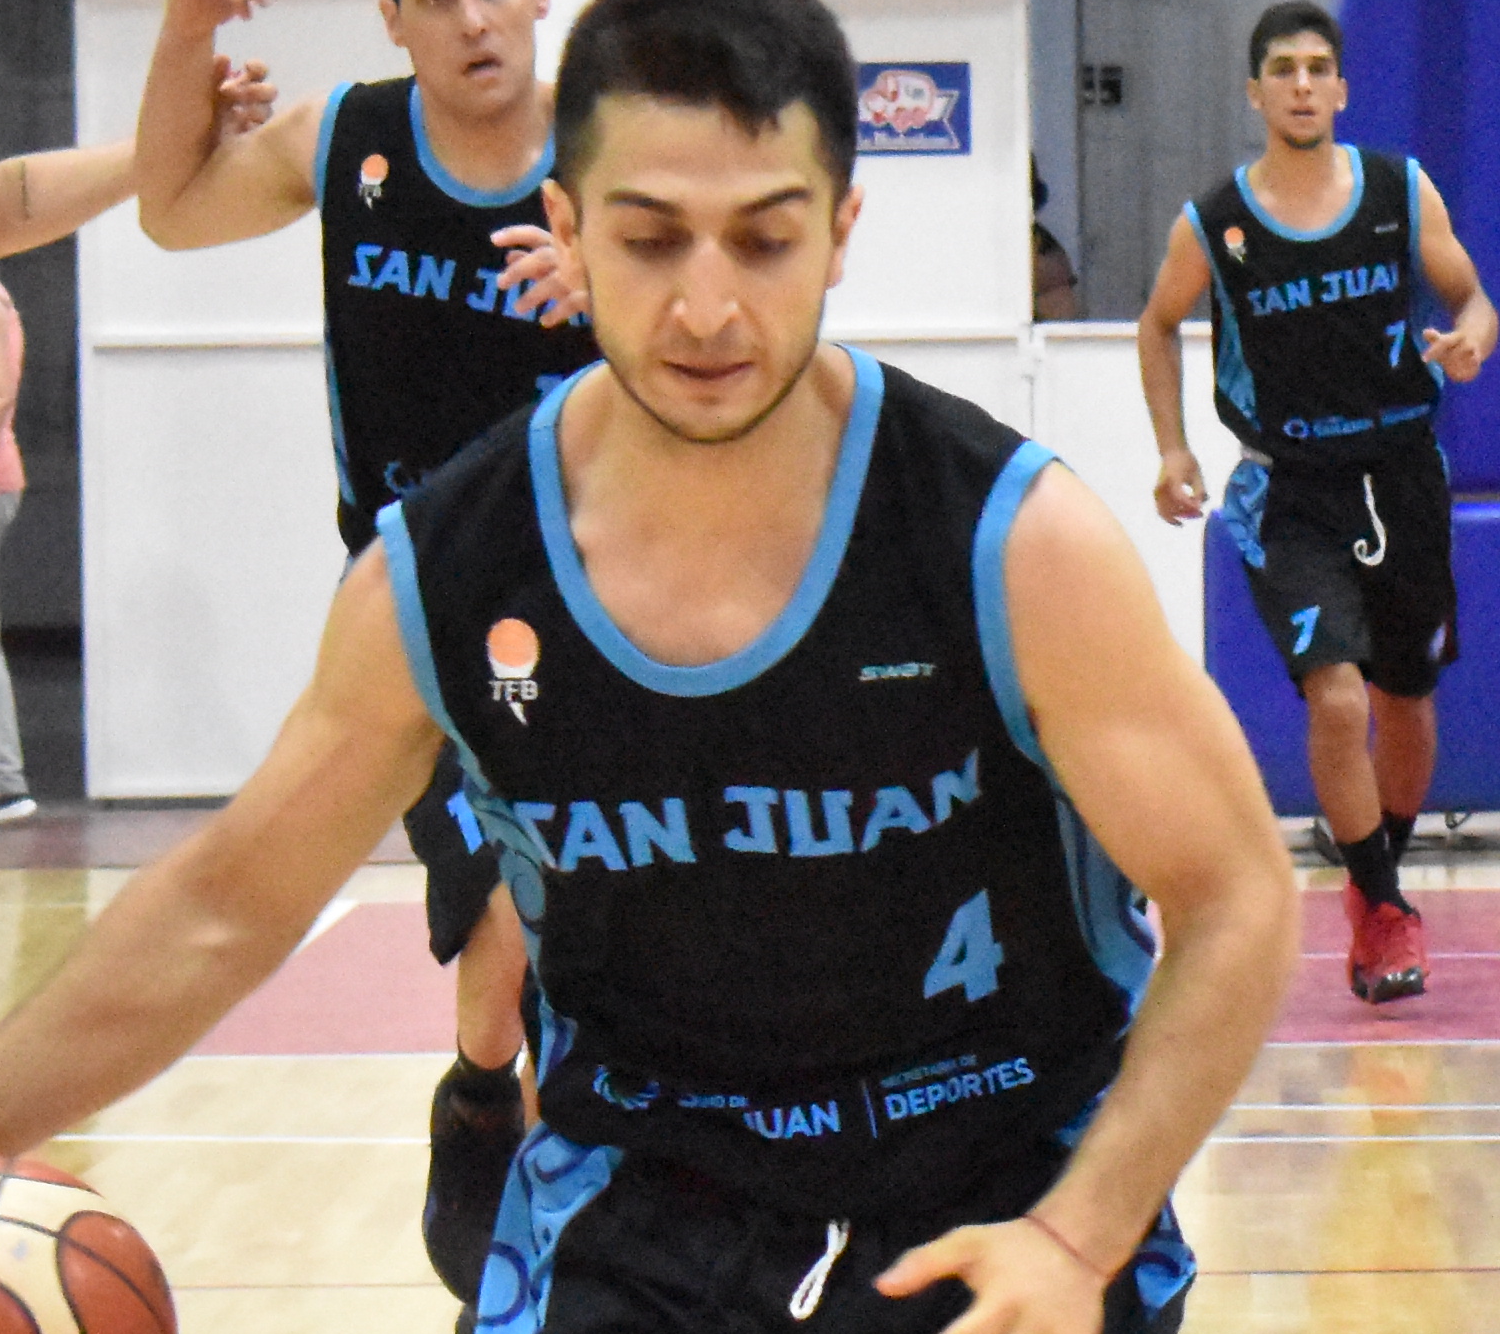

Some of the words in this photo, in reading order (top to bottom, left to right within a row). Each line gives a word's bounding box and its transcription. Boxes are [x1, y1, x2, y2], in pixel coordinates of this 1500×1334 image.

[347, 242, 456, 301] SAN
[1385, 320, 1406, 368] 7
[1289, 604, 1322, 656] 7
[488, 679, 539, 701] TFB
[723, 748, 981, 858] JUAN
[922, 887, 1005, 1003] 4
[884, 1056, 1037, 1121] DEPORTES
